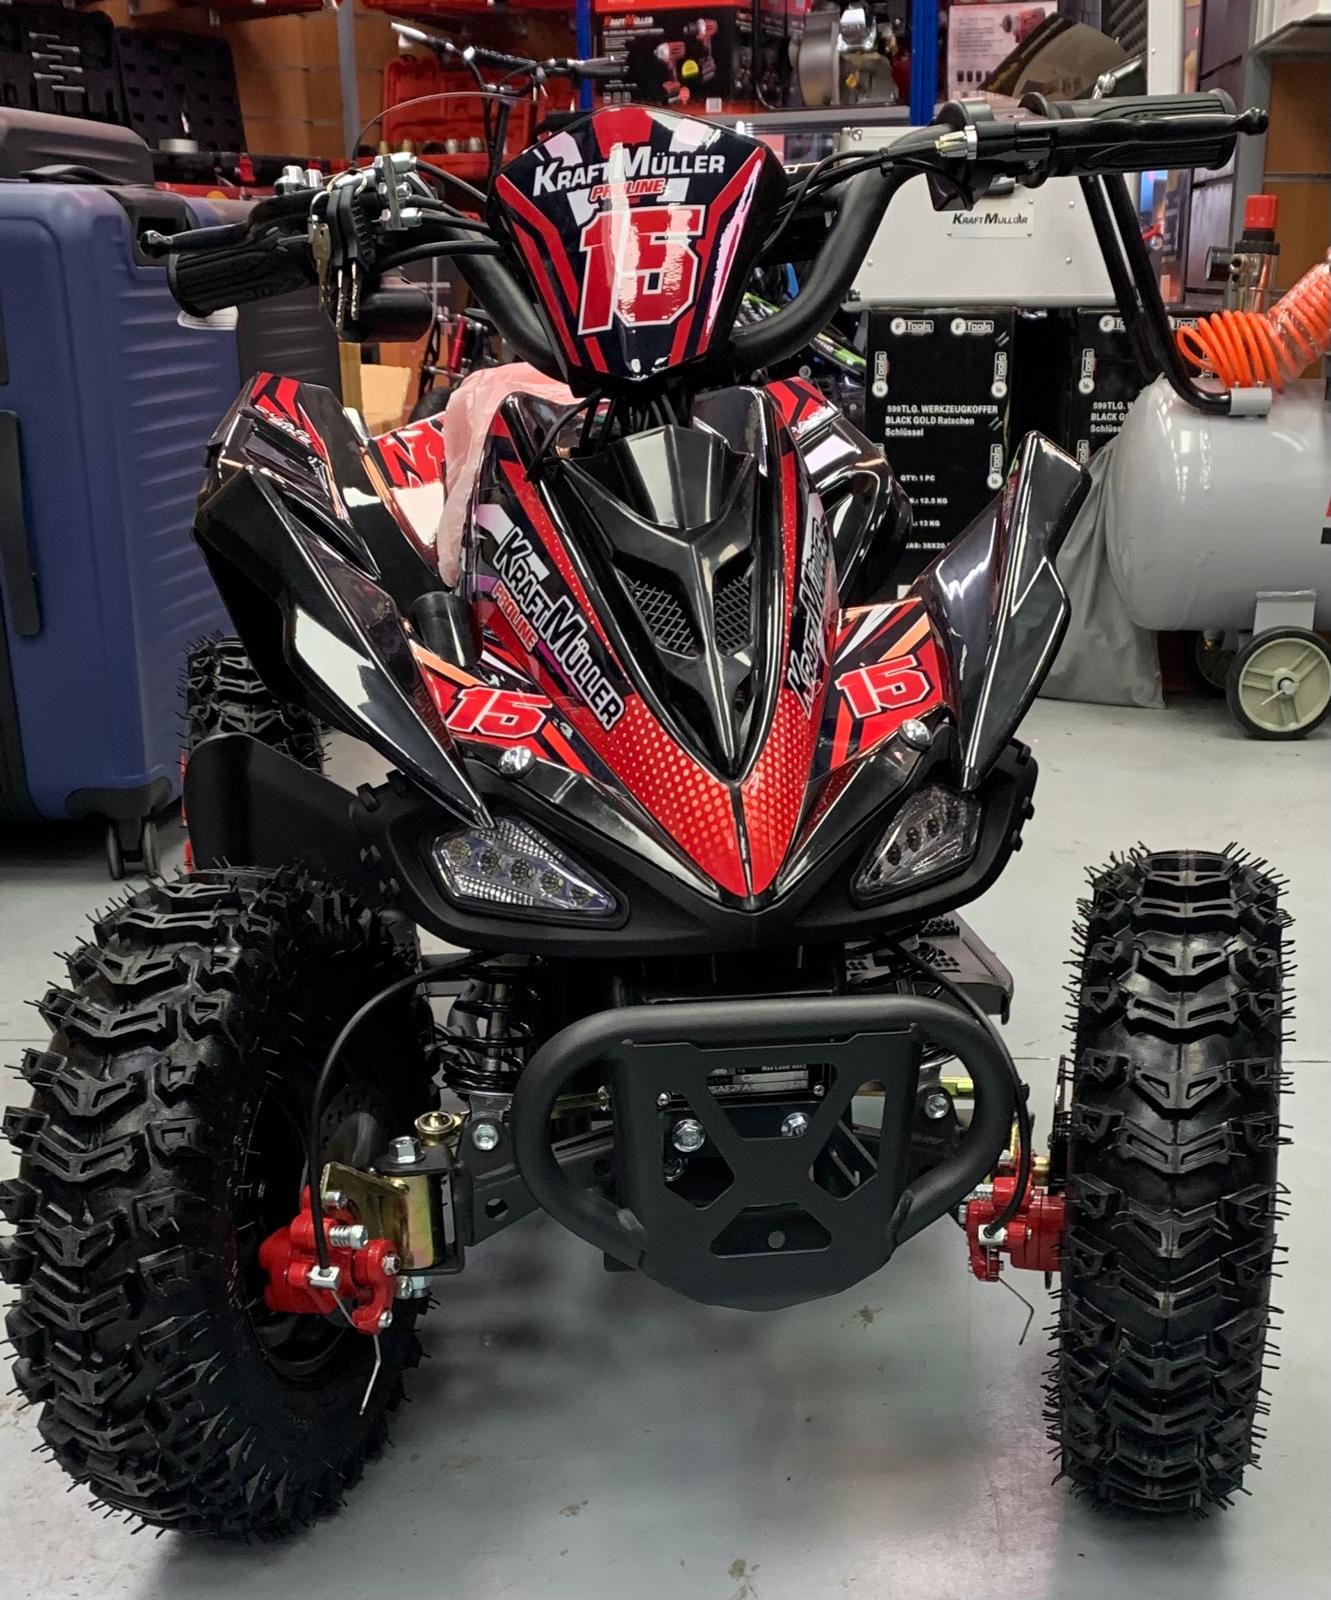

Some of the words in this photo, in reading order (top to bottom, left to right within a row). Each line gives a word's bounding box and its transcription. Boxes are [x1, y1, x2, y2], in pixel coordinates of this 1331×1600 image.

[590, 177, 667, 202] PRLINE
[577, 204, 706, 335] 15
[885, 416, 912, 425] BLACK
[913, 416, 937, 425] GOLD
[938, 416, 975, 425] Ratschen
[921, 405, 998, 414] WERKZEUGKOFFER
[1090, 413, 1117, 421] BLACK
[885, 427, 924, 437] Schlüssel
[492, 580, 538, 652] PROLINE
[835, 653, 930, 718] 15
[446, 686, 553, 738] 15
